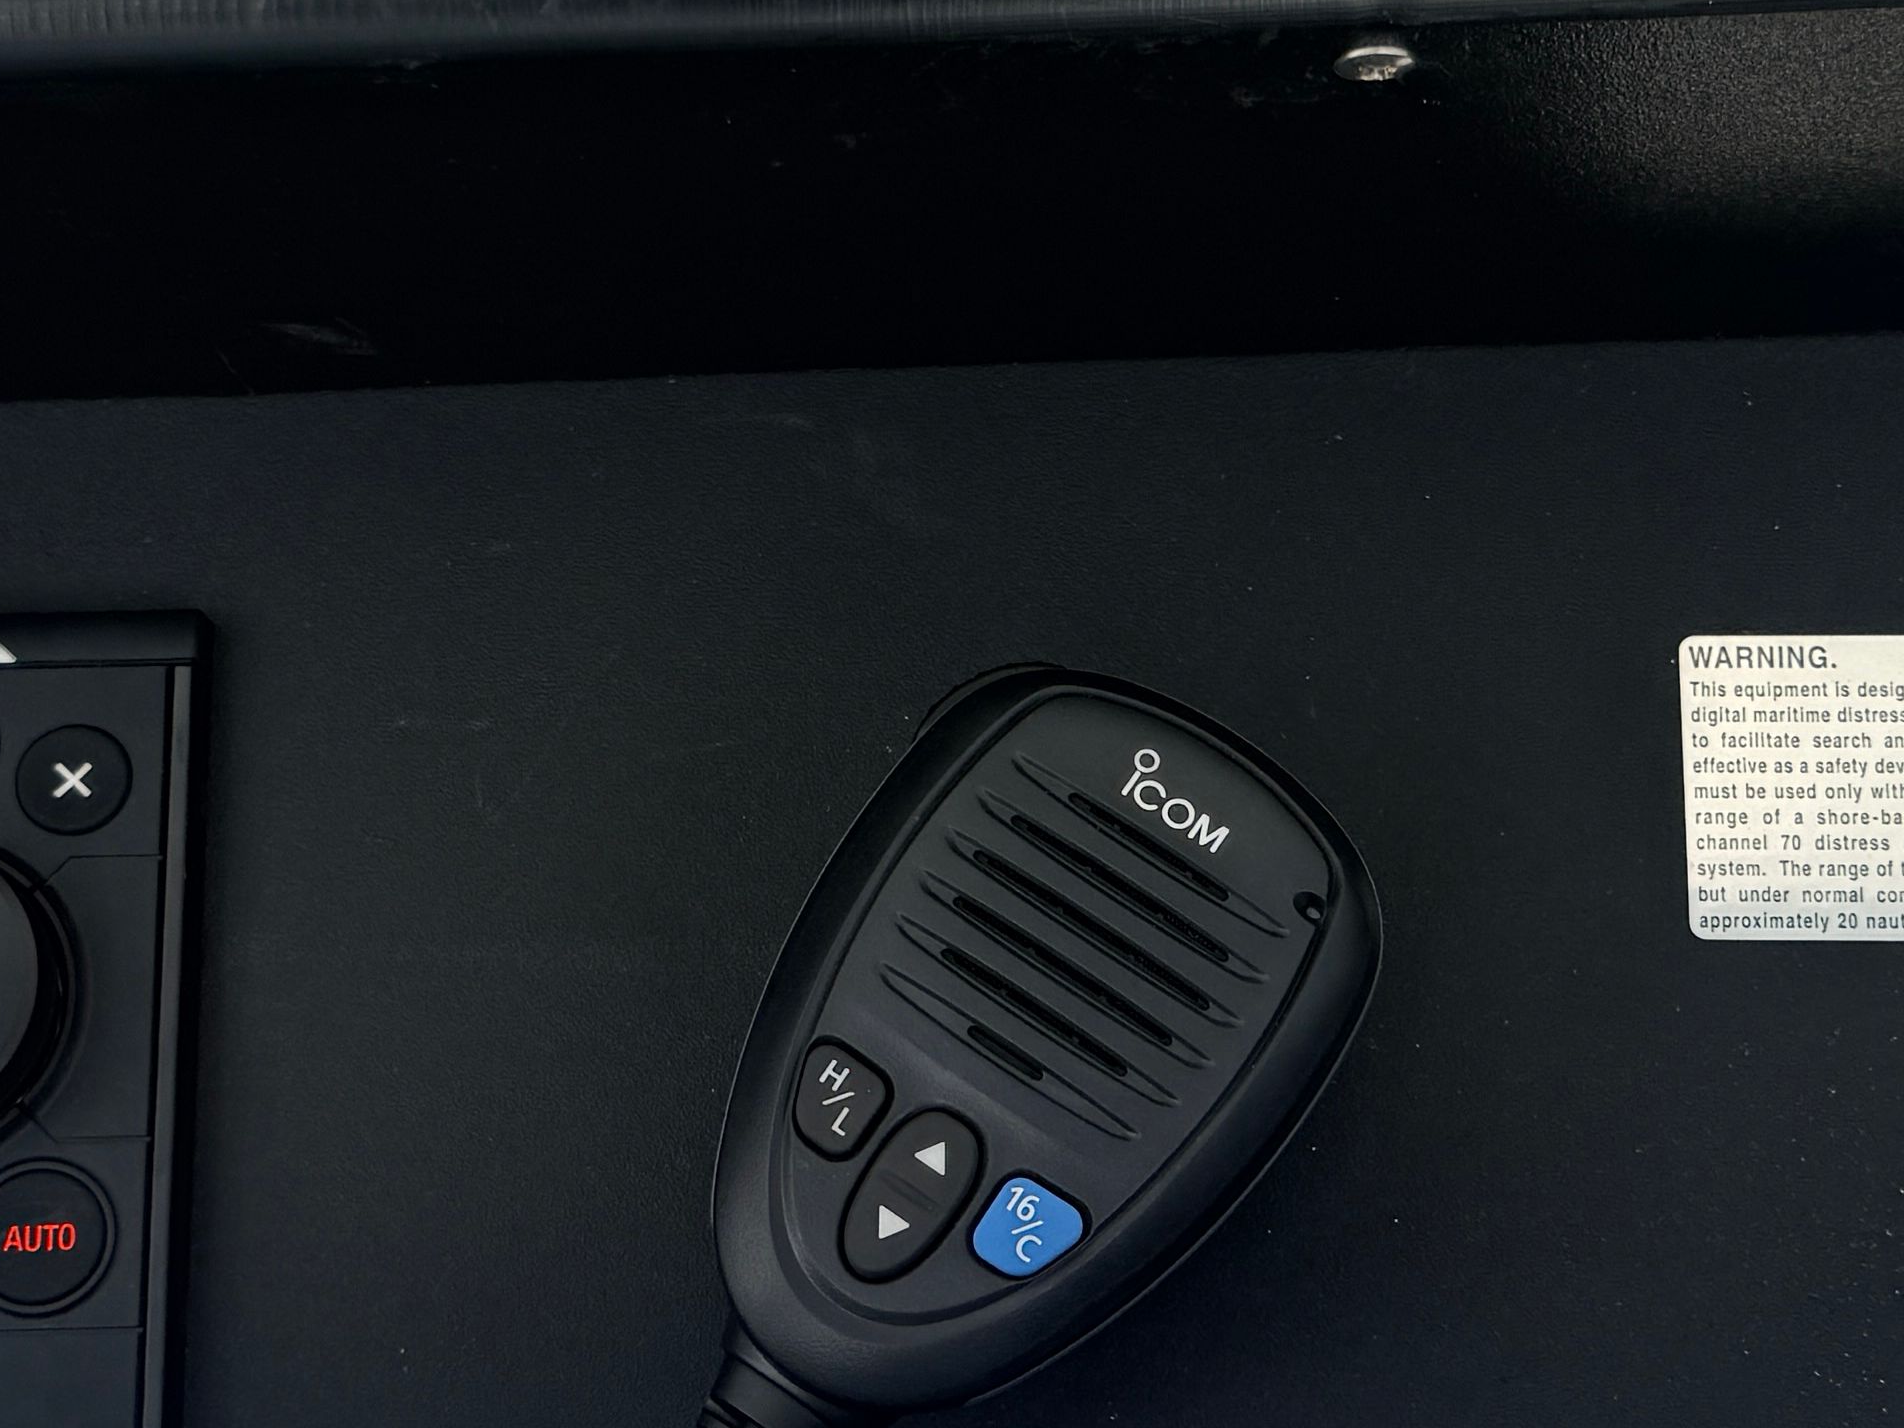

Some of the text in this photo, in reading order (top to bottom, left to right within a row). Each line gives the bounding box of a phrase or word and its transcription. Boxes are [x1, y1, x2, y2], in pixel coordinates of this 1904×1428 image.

[1687, 644, 1838, 670] WARNING.
[1688, 680, 1727, 698] This
[1733, 680, 1829, 703] equipment
[1834, 680, 1851, 698] is
[1690, 705, 1747, 728] digital
[1752, 705, 1832, 724] maritime
[1691, 732, 1710, 749] to
[1720, 731, 1801, 749] facilitate
[1812, 731, 1873, 750] search
[1692, 756, 1768, 775] effective
[1773, 760, 1794, 775] as
[1799, 760, 1810, 775] a
[1814, 756, 1869, 779] safety
[1693, 782, 1738, 800] must
[1744, 781, 1767, 800] be
[1773, 782, 1818, 800] used
[1824, 782, 1863, 805] only
[1694, 811, 1749, 830] range
[1762, 807, 1781, 826] of
[1793, 811, 1805, 826] a
[1695, 833, 1769, 852] channel
[1780, 833, 1802, 852] 70
[1814, 833, 1891, 852] distress
[1696, 860, 1767, 881] system.
[1778, 859, 1813, 878] The
[1818, 863, 1870, 882] range
[1875, 859, 1894, 878] of
[1697, 885, 1727, 903] but
[1738, 885, 1791, 904] under
[1801, 885, 1865, 904] normal
[1699, 910, 1831, 935] approximately
[1836, 911, 1859, 930] 20
[2, 1223, 76, 1253] AUTO
